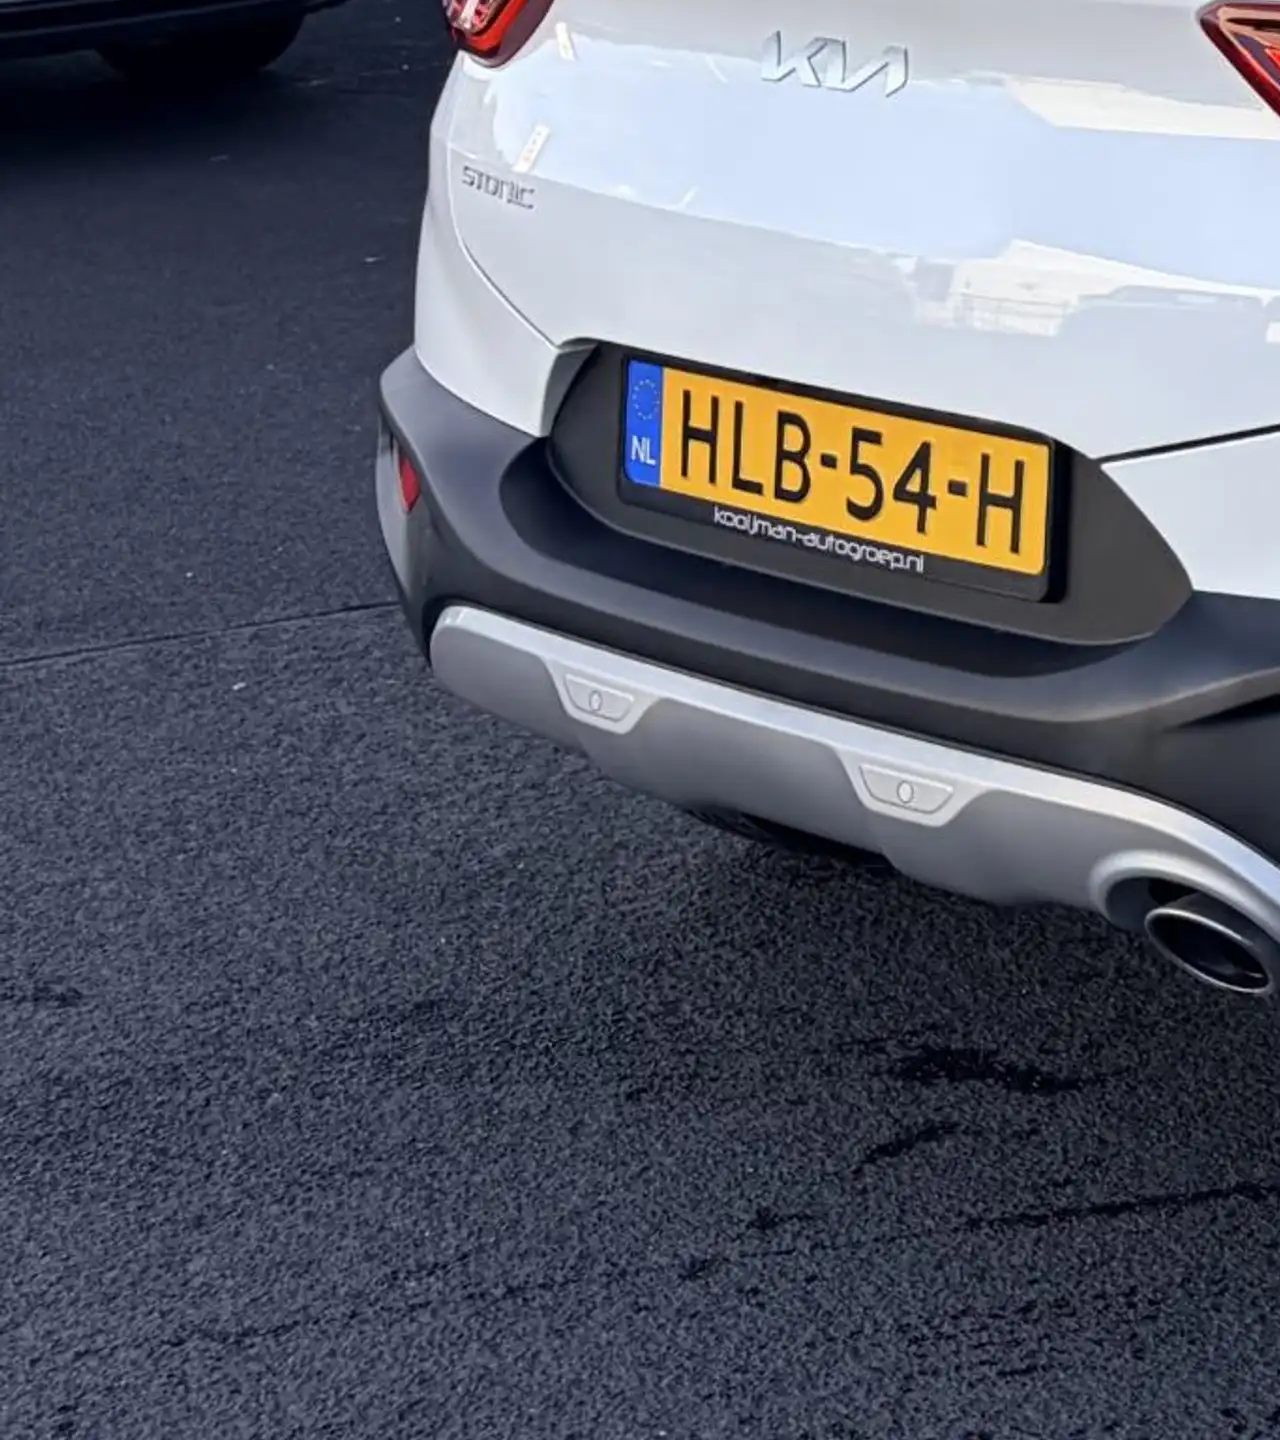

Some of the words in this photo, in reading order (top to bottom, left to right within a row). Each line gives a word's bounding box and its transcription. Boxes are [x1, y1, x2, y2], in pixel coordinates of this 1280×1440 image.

[760, 30, 909, 98] KIA
[462, 165, 535, 210] STONIC
[631, 435, 655, 466] NL
[680, 389, 1025, 554] HLB-54-H
[714, 506, 924, 573] kooijman-autogroep.nl
